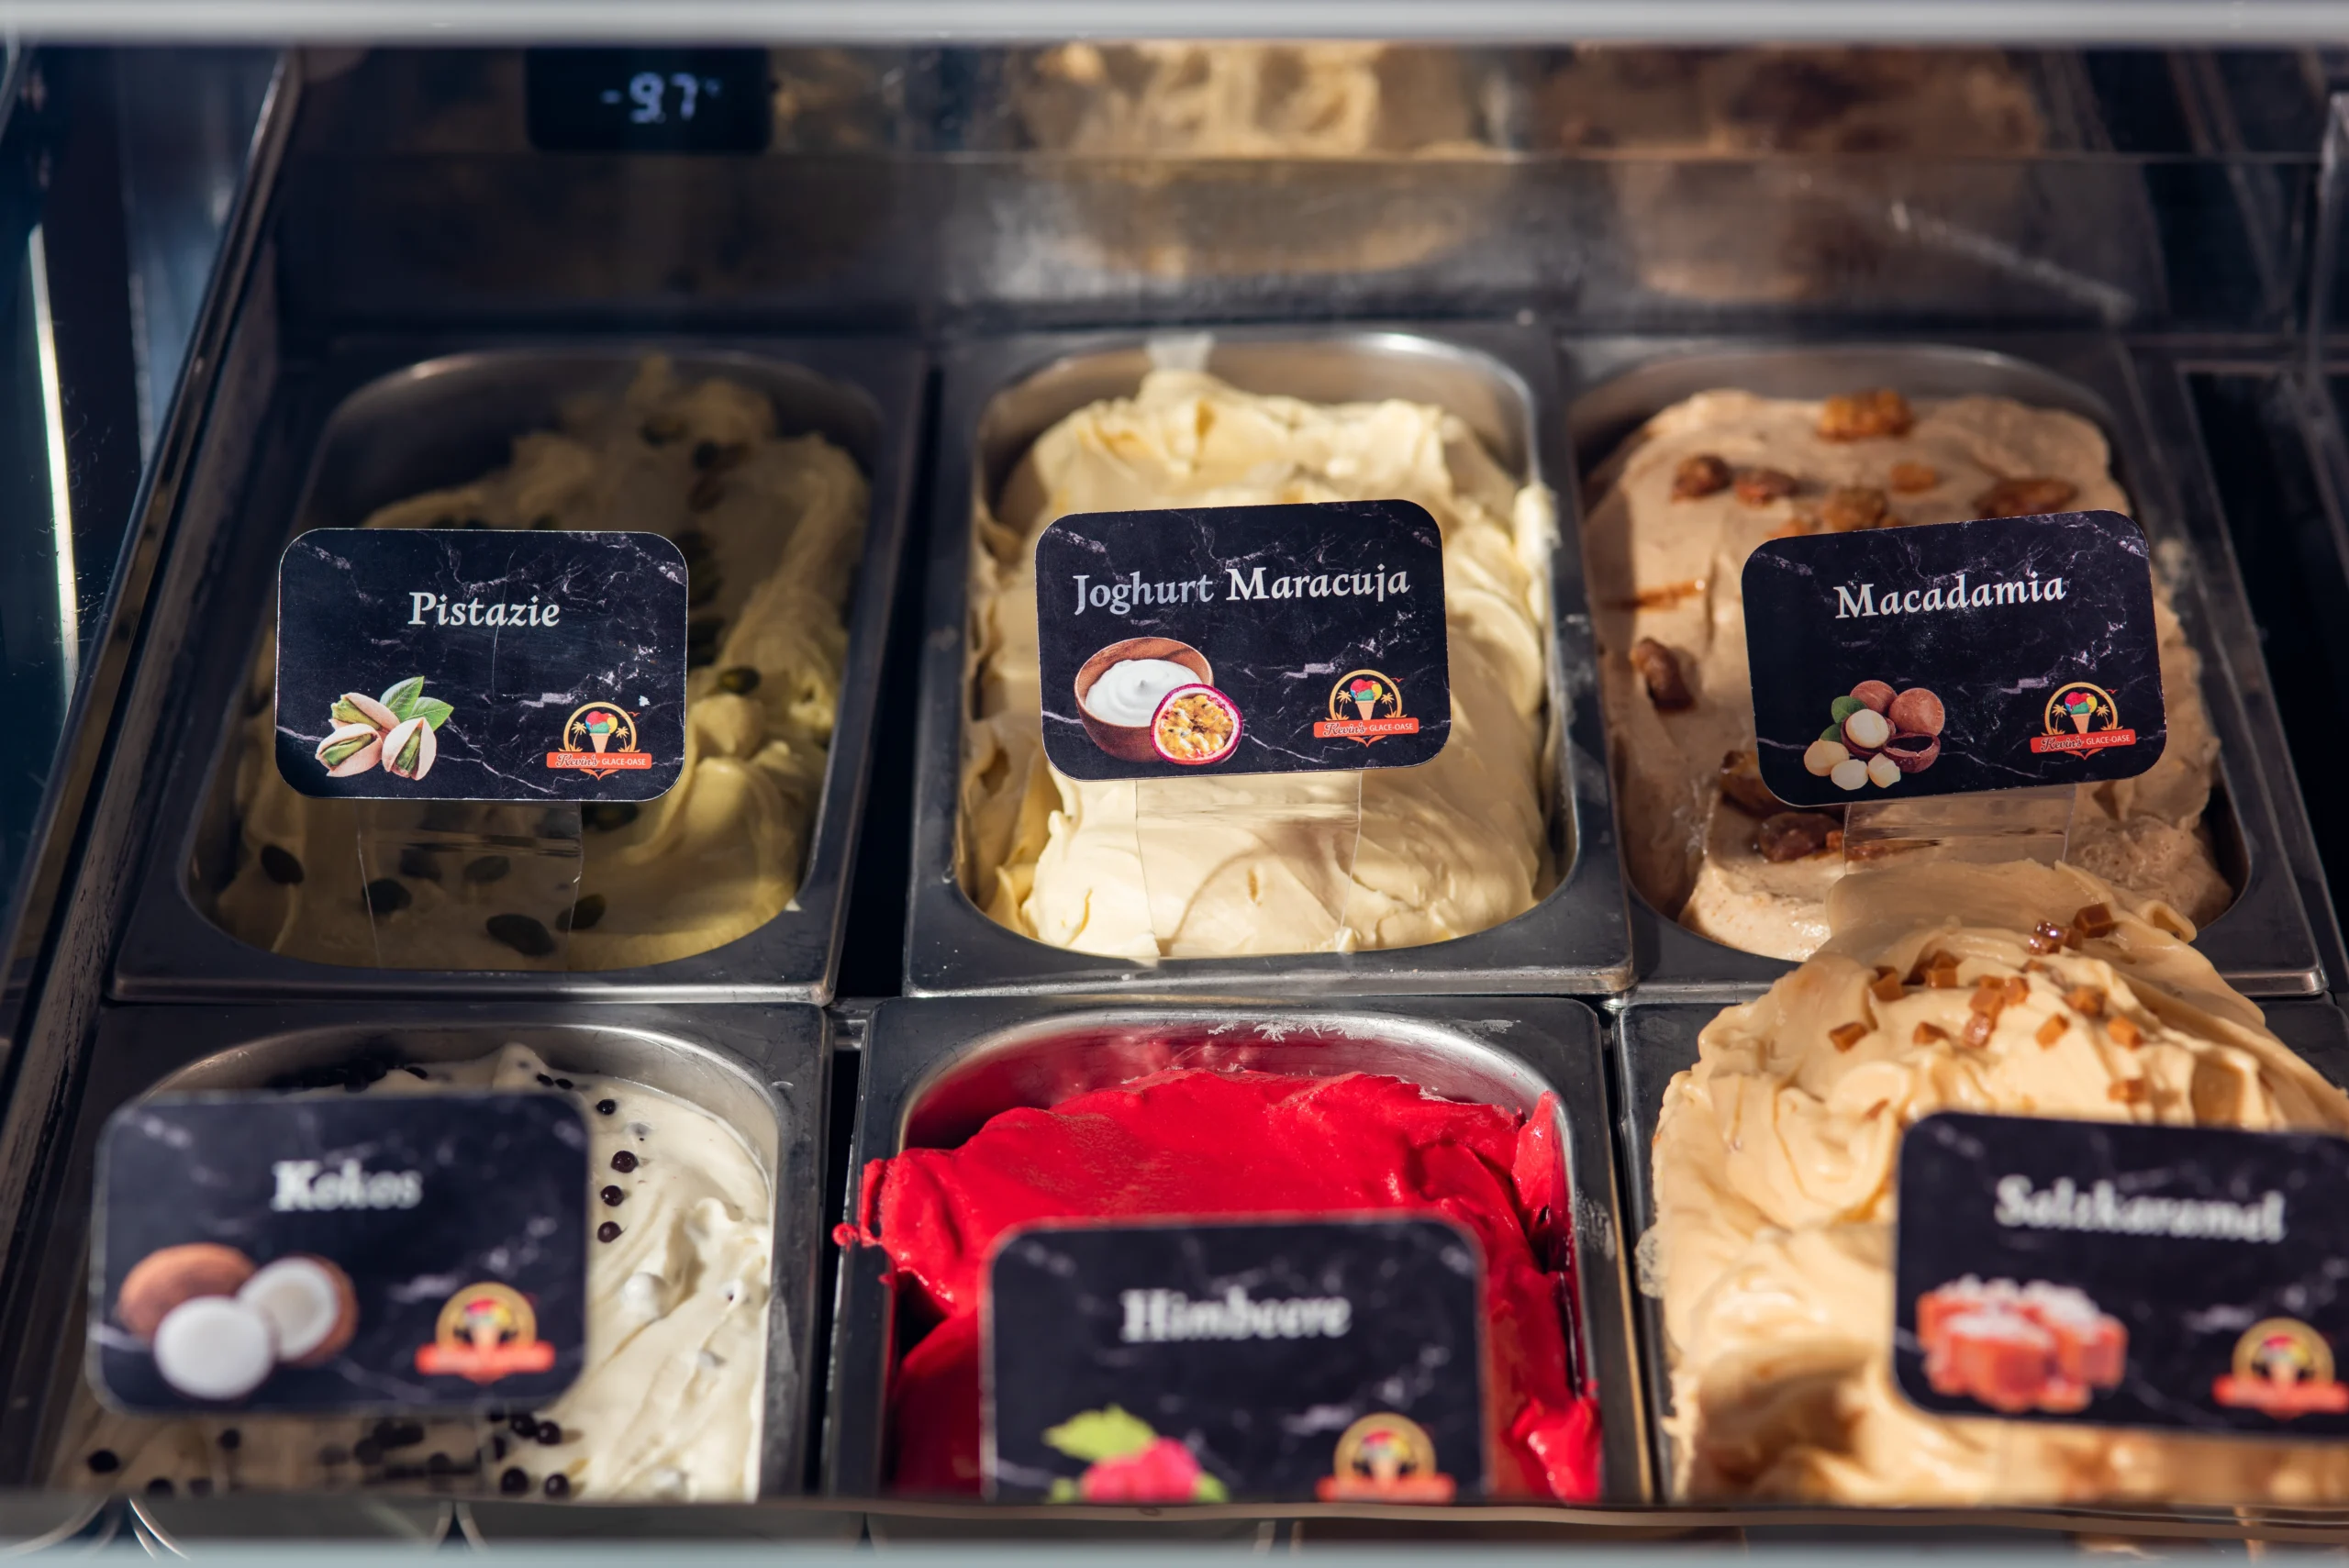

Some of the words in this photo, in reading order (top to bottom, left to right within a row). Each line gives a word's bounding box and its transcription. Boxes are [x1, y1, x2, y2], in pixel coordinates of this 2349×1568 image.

[407, 592, 561, 627] Pistazie
[1073, 571, 1215, 616] Joghurt
[1226, 563, 1410, 602] Maracuja
[1833, 571, 2066, 619] Macadamia
[1323, 721, 1366, 737] Kevin's
[1369, 723, 1414, 732] GLACE-OASE
[2040, 735, 2083, 751] Kevin's
[2086, 734, 2131, 746] GLACE-OASE
[555, 753, 598, 768] Kevin's
[601, 758, 646, 766] GLACE-OASE
[271, 1158, 423, 1212] Kokos
[1119, 1284, 1352, 1342] Himbeere
